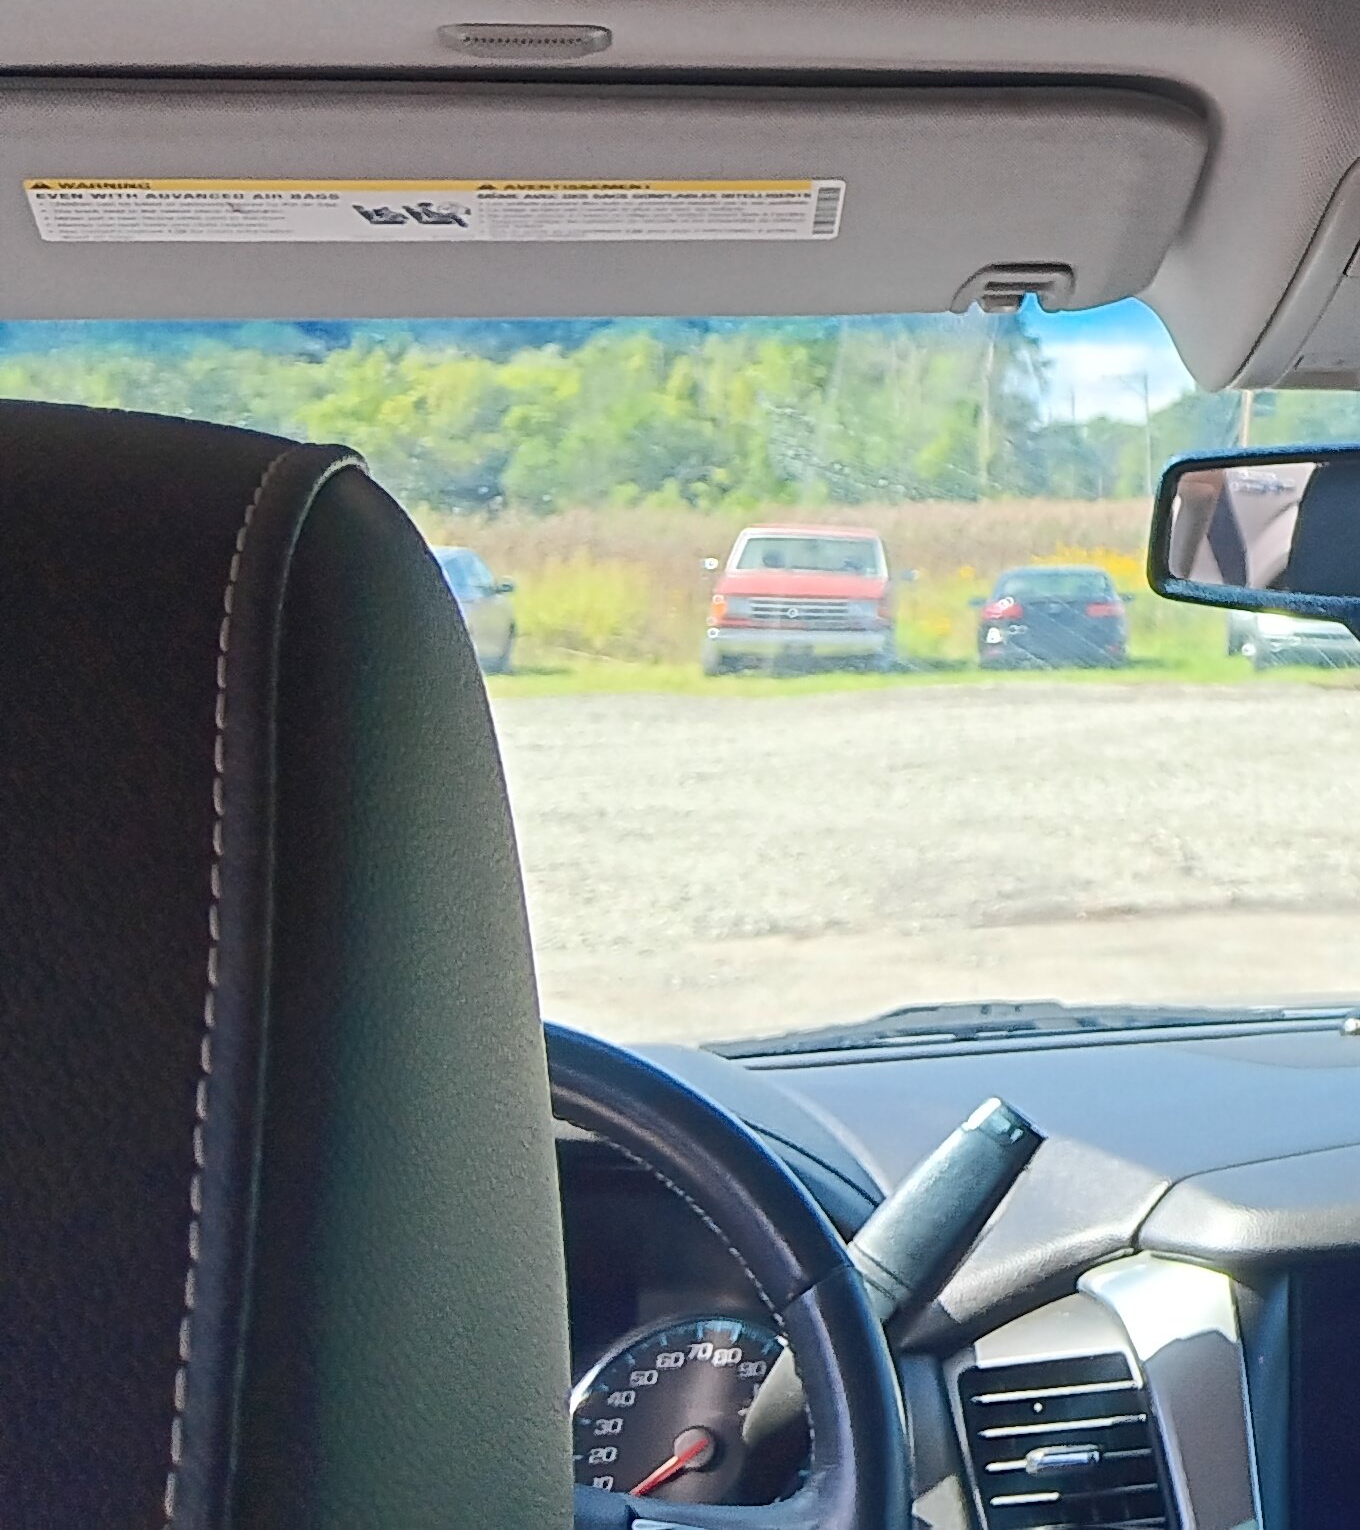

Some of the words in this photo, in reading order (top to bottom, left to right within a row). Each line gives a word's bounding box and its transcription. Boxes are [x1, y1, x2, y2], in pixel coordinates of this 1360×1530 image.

[58, 182, 151, 190] WARNING
[656, 1351, 685, 1369] 60
[688, 1342, 714, 1361] 70
[712, 1347, 743, 1367] 80
[630, 1369, 659, 1387] 50
[738, 1360, 767, 1378] 90
[607, 1390, 636, 1408] 40
[593, 1418, 624, 1436] 30
[588, 1446, 618, 1465] 20
